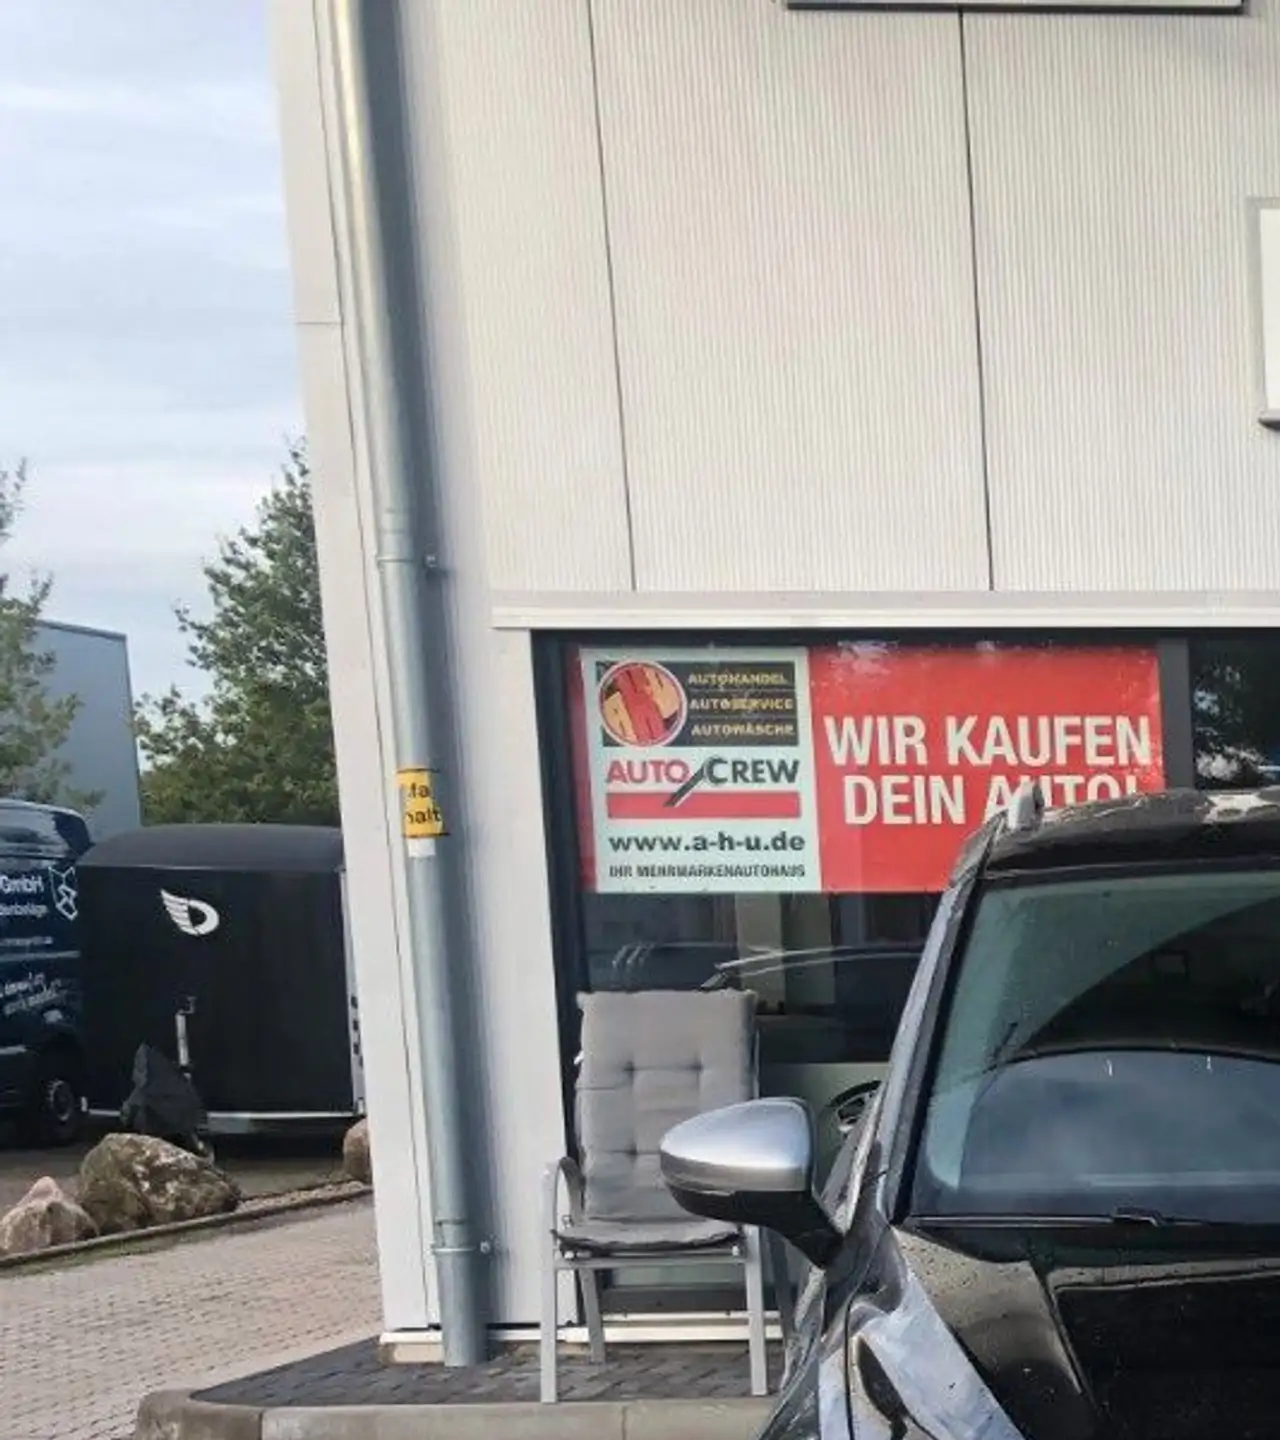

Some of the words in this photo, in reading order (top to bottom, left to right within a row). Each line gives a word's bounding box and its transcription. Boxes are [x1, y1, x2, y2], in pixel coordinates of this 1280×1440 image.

[688, 673, 787, 685] AUTOHANDEL
[689, 698, 794, 710] AUTOSERVICE
[823, 714, 928, 768] WIR
[945, 714, 1151, 768] KAUFEN
[844, 774, 966, 825] DEIN
[608, 831, 806, 852] www.a-h-u.de
